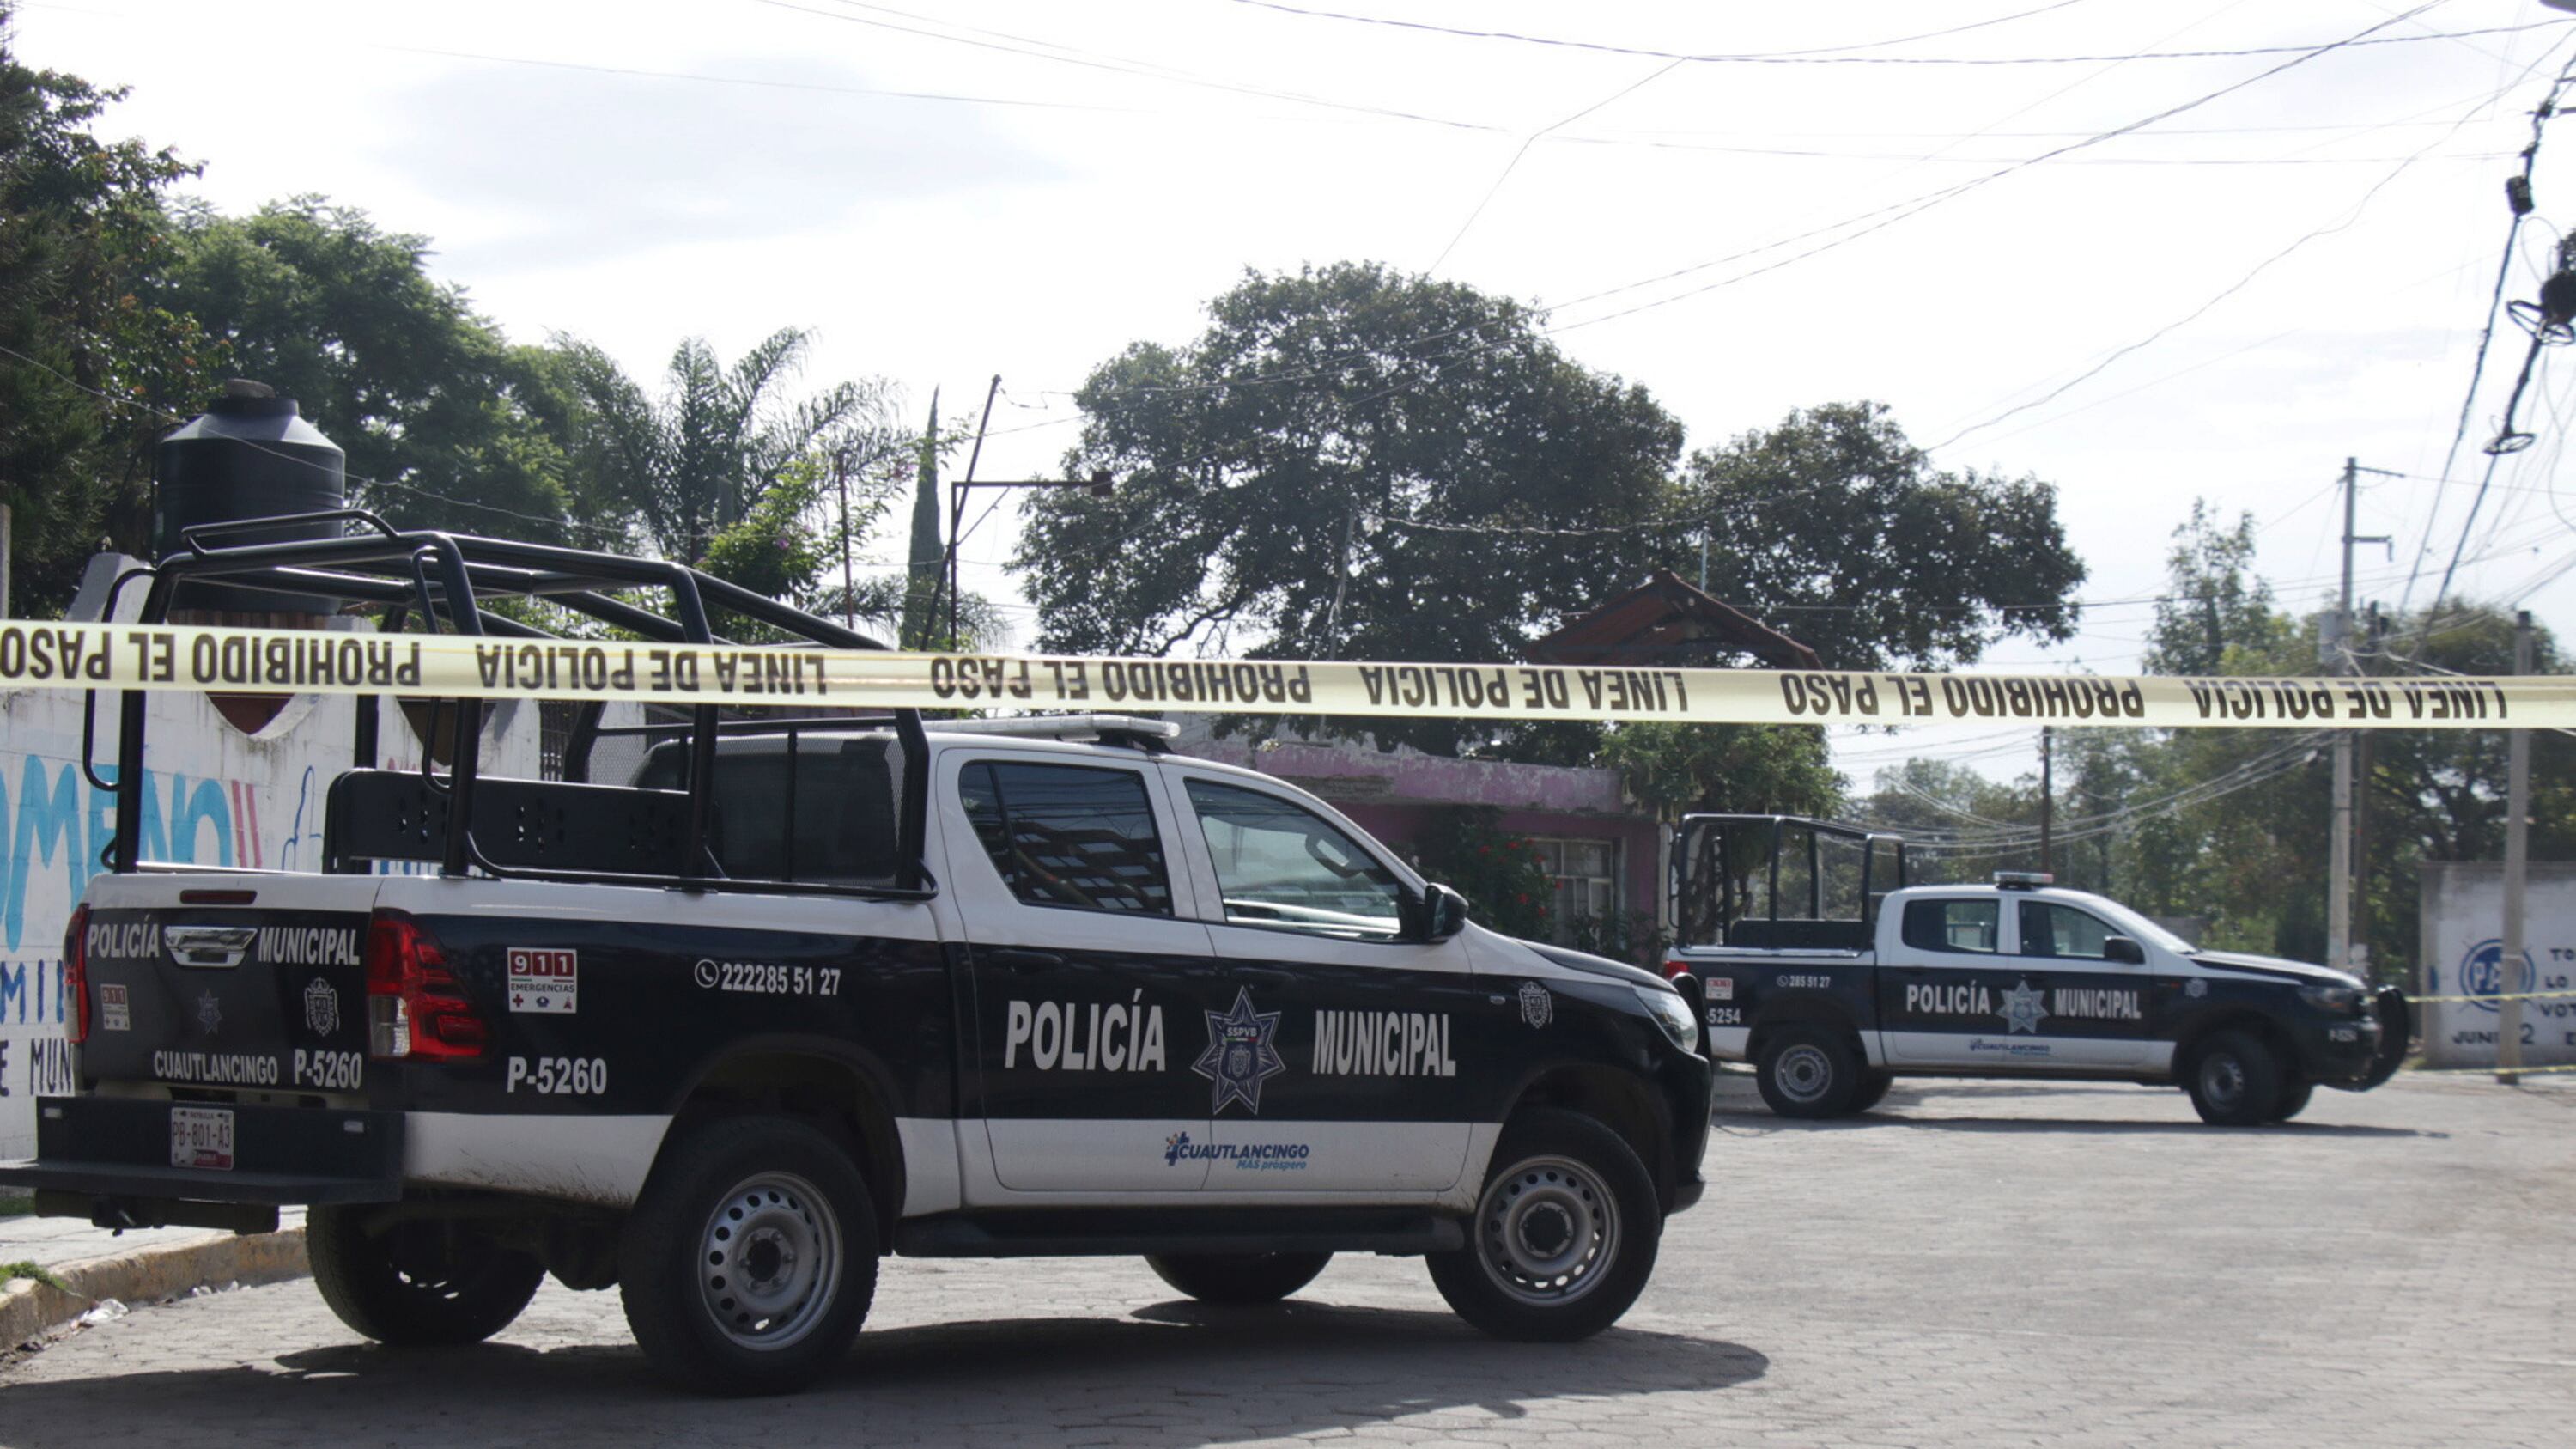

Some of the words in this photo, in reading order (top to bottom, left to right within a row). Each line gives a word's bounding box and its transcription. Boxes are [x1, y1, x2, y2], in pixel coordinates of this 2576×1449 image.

[1, 628, 111, 681] PASO
[129, 634, 174, 682] EL
[192, 638, 421, 686] PROHIBIDO
[477, 643, 635, 691] POLICIA
[650, 649, 700, 692] DE
[714, 652, 827, 695] LINEA
[931, 657, 1032, 699] PASO
[1042, 661, 1089, 700] EL
[1102, 661, 1312, 703] PROHIBIDO
[1358, 666, 1510, 709] POLICIA
[1519, 668, 1570, 709] DE
[1577, 669, 1688, 712] LINEA
[1780, 673, 1879, 715] PASO
[1885, 675, 1933, 716] EL
[1941, 676, 2145, 718] PROHIBIDO
[2184, 679, 2334, 720] POLICIA
[2344, 681, 2391, 719] DE
[2393, 680, 2507, 719] LINEA
[88, 915, 160, 958] POLICÍA
[258, 928, 360, 965] MUNICIPAL
[515, 954, 568, 974] 911
[721, 963, 788, 993] 222285
[794, 967, 813, 995] 51
[820, 969, 841, 995] 27
[511, 983, 575, 993] EMERGENCIAS
[1906, 980, 1990, 1014] POLICÍA
[2054, 989, 2142, 1019] MUNICIPAL
[1005, 989, 1165, 1072] POLICÍA
[1312, 1010, 1455, 1076] MUNICIPAL
[2519, 1023, 2535, 1045] 2
[155, 1050, 278, 1084] CUAUTLANCINGO
[294, 1049, 362, 1089] P-5260
[507, 1057, 607, 1094] P-5260
[1179, 1144, 1309, 1159] CUAUTLANCINGO
